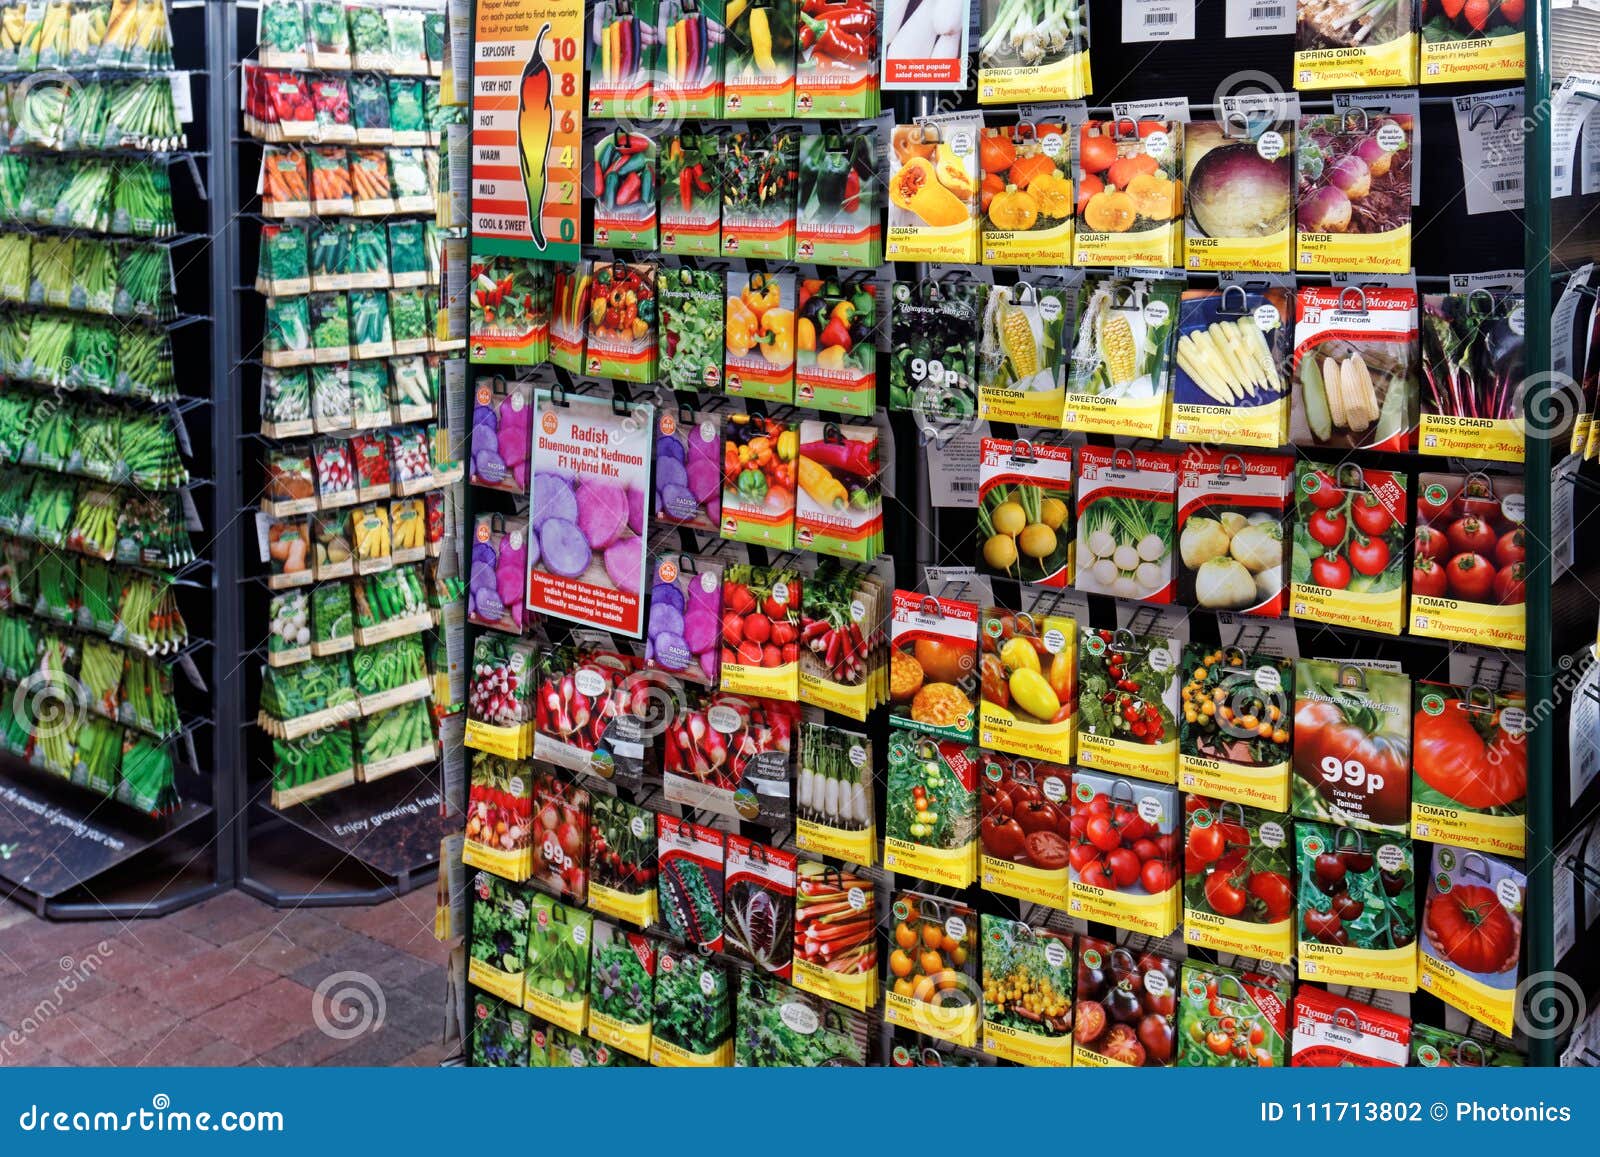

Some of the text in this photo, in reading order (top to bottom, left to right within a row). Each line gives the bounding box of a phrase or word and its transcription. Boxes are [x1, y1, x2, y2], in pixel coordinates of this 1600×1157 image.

[503, 12, 524, 21] packet
[558, 10, 577, 19] variety
[500, 26, 513, 34] your
[482, 38, 576, 62] EXPLOSIVE 10
[1428, 40, 1493, 52] STRAWBERRY
[1300, 49, 1366, 60] SPRING ONION
[926, 64, 951, 72] popular
[1336, 58, 1363, 66] Bunching
[984, 67, 1039, 77] SPRING ONION
[1314, 68, 1401, 81] Thompson Morgan
[481, 73, 575, 96] VERY HOT 8
[1391, 92, 1415, 100] Morgan
[1129, 102, 1156, 110] Thompson
[1164, 100, 1184, 108] Morgan
[481, 111, 574, 133] HOT 6
[480, 145, 573, 169] WARM 4
[479, 181, 573, 205] MILD 2
[479, 218, 574, 240] COOL & SWEET 0
[828, 224, 855, 234] PEPPER
[985, 232, 1014, 240] SQUASH
[1079, 234, 1110, 242] SQUASH
[1301, 234, 1332, 242] SWEDE
[1190, 239, 1218, 247] SWEDE
[1201, 258, 1282, 269] Thompson Morgan
[1314, 254, 1402, 266] Thompson Morgan
[911, 358, 958, 387] 99p
[981, 387, 1024, 399] SWEETCORN
[1069, 395, 1117, 406] SWEETCORN
[1178, 405, 1231, 415] SWEETCORN
[1426, 416, 1493, 428] SWISS CHARD
[571, 424, 608, 445] Radish
[1425, 426, 1448, 434] Fantasy
[539, 437, 643, 466] Bluemoon and Redmoon
[558, 455, 619, 477] F1 Hybrid Mix
[1380, 485, 1395, 503] EXTRA
[1384, 480, 1401, 499] 25%
[534, 574, 636, 606] Unique red and blue skin and flesh
[1296, 584, 1332, 596] TOMATO
[544, 586, 624, 614] radish from Asian breeding
[1309, 595, 1324, 604] Craig
[1418, 596, 1458, 609] TOMATO
[544, 596, 566, 611] Visually
[568, 601, 594, 617] stunning
[602, 610, 622, 623] salads
[1416, 606, 1441, 615] Alicante
[1308, 606, 1393, 629] Thompson Morgan
[669, 646, 690, 656] RADISH
[723, 664, 745, 672] RADISH
[801, 673, 821, 684] RADISH
[984, 715, 1012, 727] TOMATO
[1083, 735, 1115, 746] TOMATO
[1093, 753, 1169, 778] Thompson Morgan
[1185, 757, 1219, 770] TOMATO
[1320, 756, 1385, 794] 99p
[1196, 778, 1278, 801] Thompson Morgan
[1337, 799, 1362, 809] Tomato
[1347, 811, 1369, 819] Russian
[1417, 805, 1458, 819] TOMATO
[334, 819, 369, 837] Enjoy
[371, 803, 418, 827] growing
[1416, 815, 1441, 825] Country
[1442, 819, 1458, 827] Taste
[888, 838, 915, 851] TOMATO
[543, 840, 573, 870] 99p
[985, 858, 1015, 870] TOMATO
[1072, 882, 1104, 896] TOMATO
[1083, 904, 1160, 929] Thompson Morgan
[1191, 912, 1225, 925] TOMATO
[1202, 933, 1285, 959] Thompson Morgan
[1304, 944, 1343, 955] TOMATO
[1424, 955, 1455, 977] TOMATO
[1318, 964, 1409, 985] Thompson Morgan
[888, 992, 916, 1007] TOMATO
[987, 1022, 1016, 1036] TOMATO
[1324, 1031, 1352, 1044] TOMATO
[1077, 1048, 1108, 1065] TOMATO
